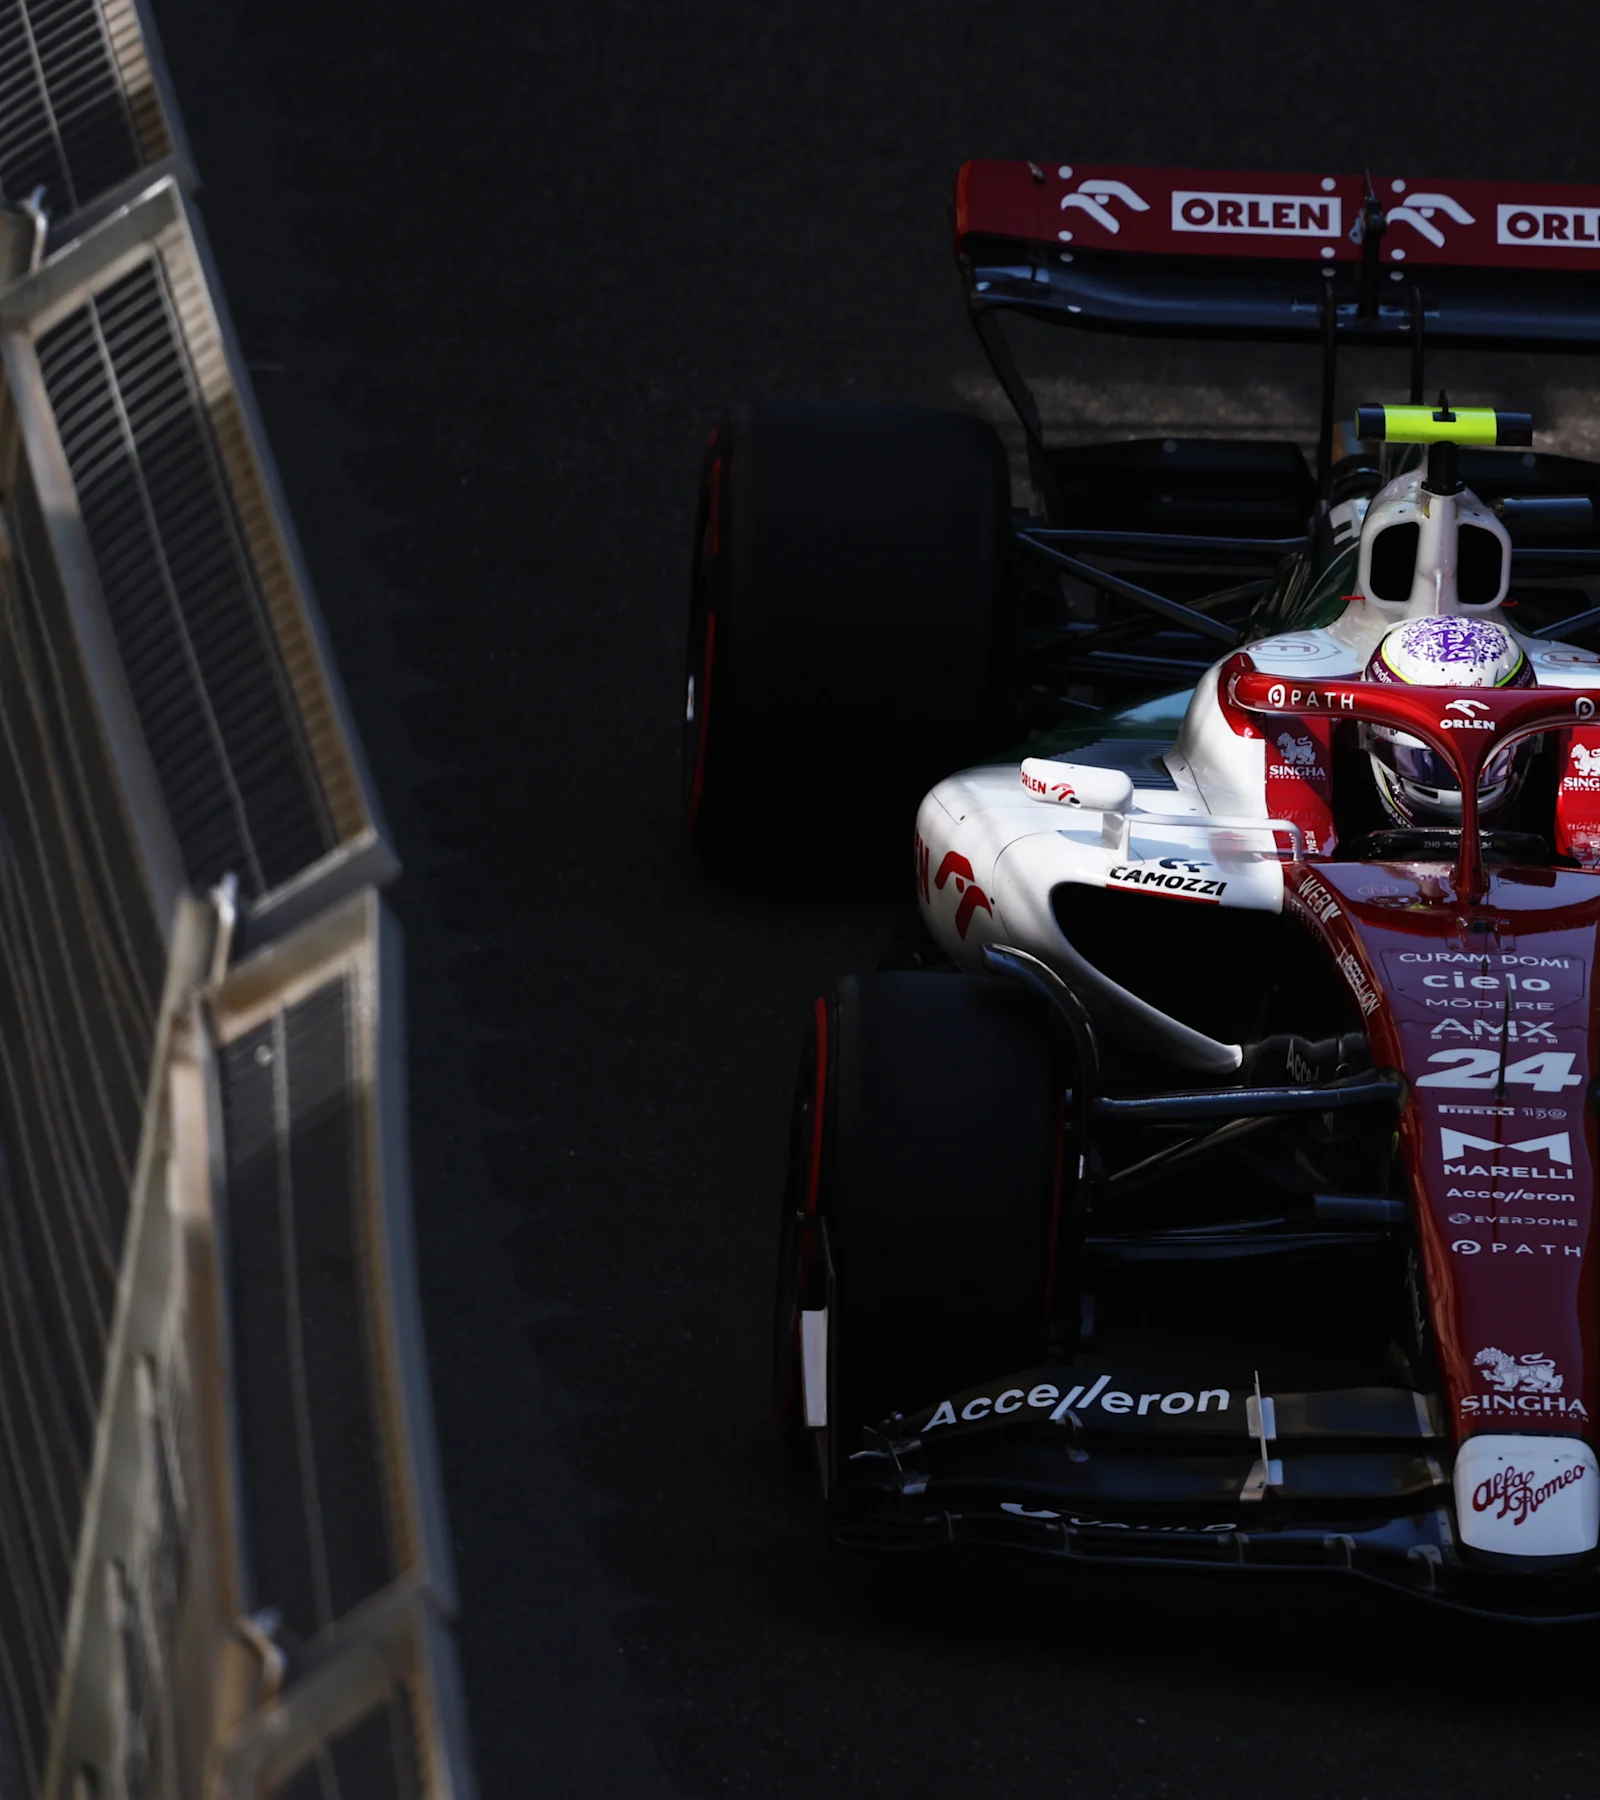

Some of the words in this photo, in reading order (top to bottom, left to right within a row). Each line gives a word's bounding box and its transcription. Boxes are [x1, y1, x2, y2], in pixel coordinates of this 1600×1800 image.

[1181, 198, 1329, 230] ORLEN
[1290, 689, 1355, 710] PATH
[1439, 719, 1496, 731] ORLEN
[1269, 765, 1326, 776] SINGHA
[1109, 866, 1228, 896] CAMOZZI
[1399, 952, 1492, 964] CURAM
[1501, 954, 1570, 969] DOMI
[1422, 971, 1551, 992] cielo
[1430, 1018, 1557, 1038] AMX
[1415, 1047, 1584, 1093] 24
[1438, 1104, 1516, 1116] PIRELLI
[1443, 1164, 1574, 1180] MARELLI
[1446, 1187, 1576, 1203] Accelleron
[1474, 1215, 1578, 1227] EVERDOME
[1491, 1242, 1582, 1258] PATH
[920, 1374, 1231, 1433] Accelleron
[1460, 1394, 1589, 1416] SINGHA
[1460, 1409, 1590, 1423] CORPORATION
[1472, 1465, 1525, 1520] Alfa
[1508, 1464, 1586, 1526] Romeo
